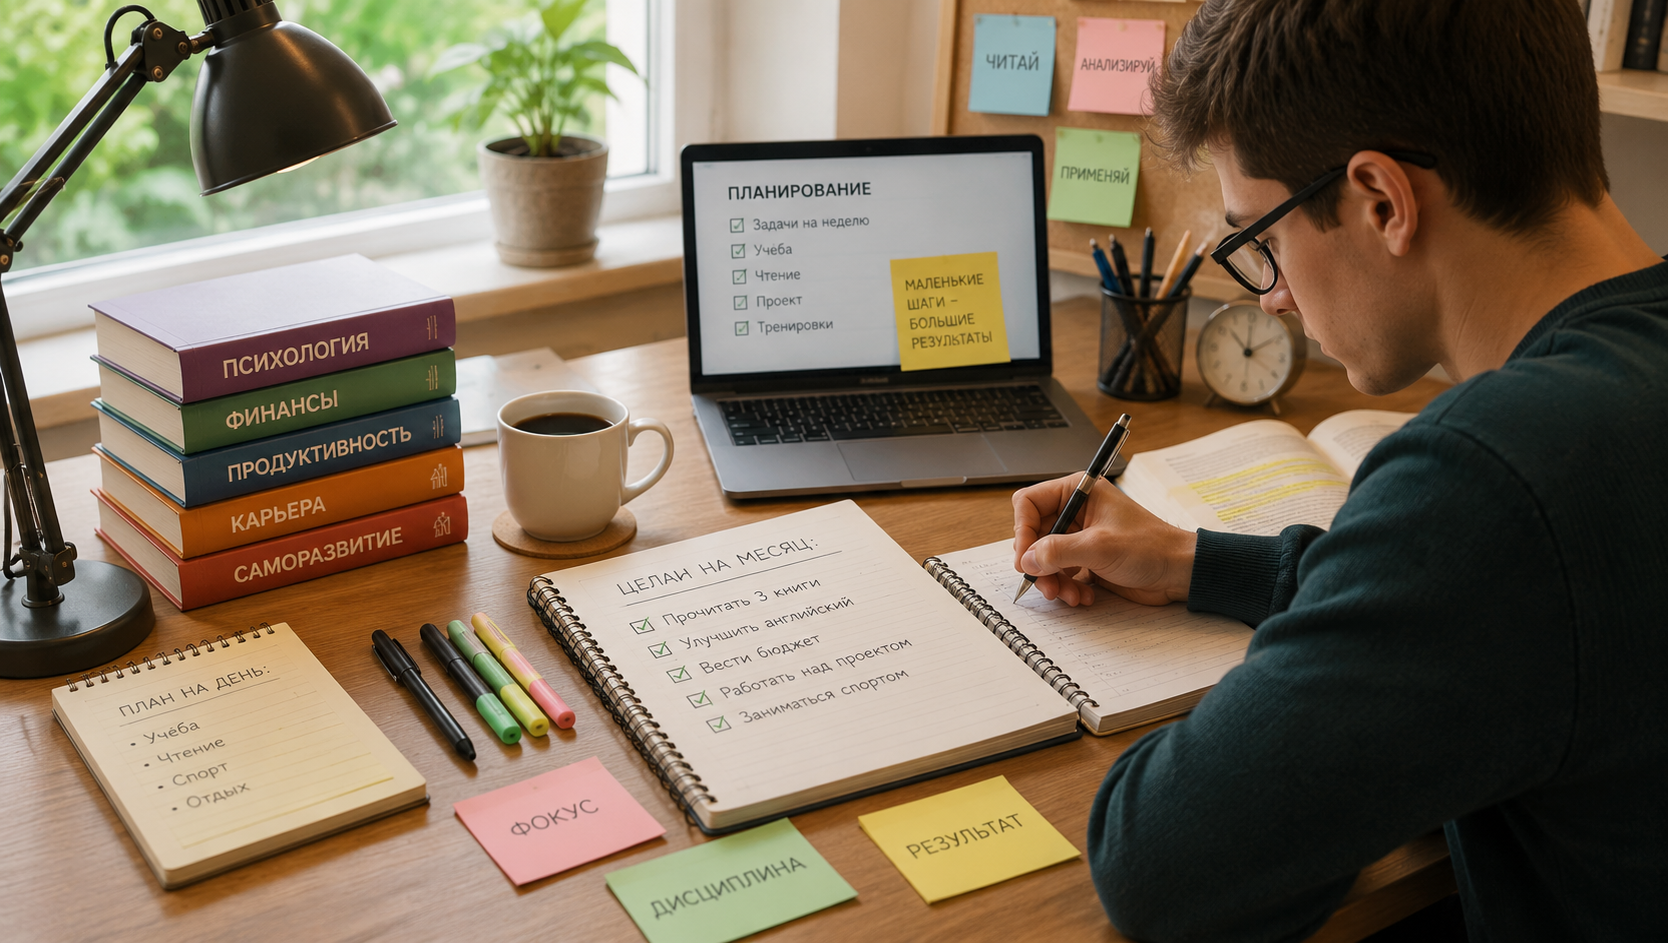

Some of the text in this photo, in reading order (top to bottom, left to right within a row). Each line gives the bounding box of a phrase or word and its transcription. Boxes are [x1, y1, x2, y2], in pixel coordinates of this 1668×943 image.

[986, 51, 1039, 71] ЧИТАЙ
[1080, 57, 1155, 73] АНАЛИЗИРУЙ
[728, 182, 872, 200] ПЛАНИРОВАНИЕ
[1060, 166, 1130, 185] ПРИМЕНЯЙ
[753, 216, 870, 232] Задачи на неделю
[755, 269, 801, 282] Чтение
[905, 273, 984, 291] МАЛЕНЬКИЕ
[756, 295, 803, 310] Проект
[907, 296, 946, 311] ШАГИ
[757, 320, 834, 336] Тренировки
[909, 313, 976, 330] БОЛЬШИЕ
[223, 332, 370, 379] ПСИХОЛОГИЯ
[225, 390, 339, 430] ФИНАНСЫ
[227, 426, 412, 483] ПРОДУКТИВНОСТЬ
[230, 496, 326, 533] КАРЬЕРА
[233, 526, 403, 583] САМОРАЗВИТИЕ
[698, 559, 731, 581] НА
[736, 537, 818, 565] МЕСЯЦ:
[662, 579, 821, 627] Прочитать 3 книги
[679, 596, 855, 651] Улучшить английский
[699, 633, 821, 674] Вести бюджет
[719, 638, 913, 699] Работать над проектом
[118, 665, 270, 717] ПЛАН НА ДЕНЬ:
[738, 669, 910, 724] Заниматься спортом
[157, 738, 226, 764] Чтение
[172, 762, 228, 786] Спорт
[186, 783, 251, 808] Отдых
[510, 799, 599, 836] ФОКУС
[906, 813, 1024, 859] РЕЗУЛЬТАТ
[650, 857, 807, 920] ДИСЦИПЛИНА
